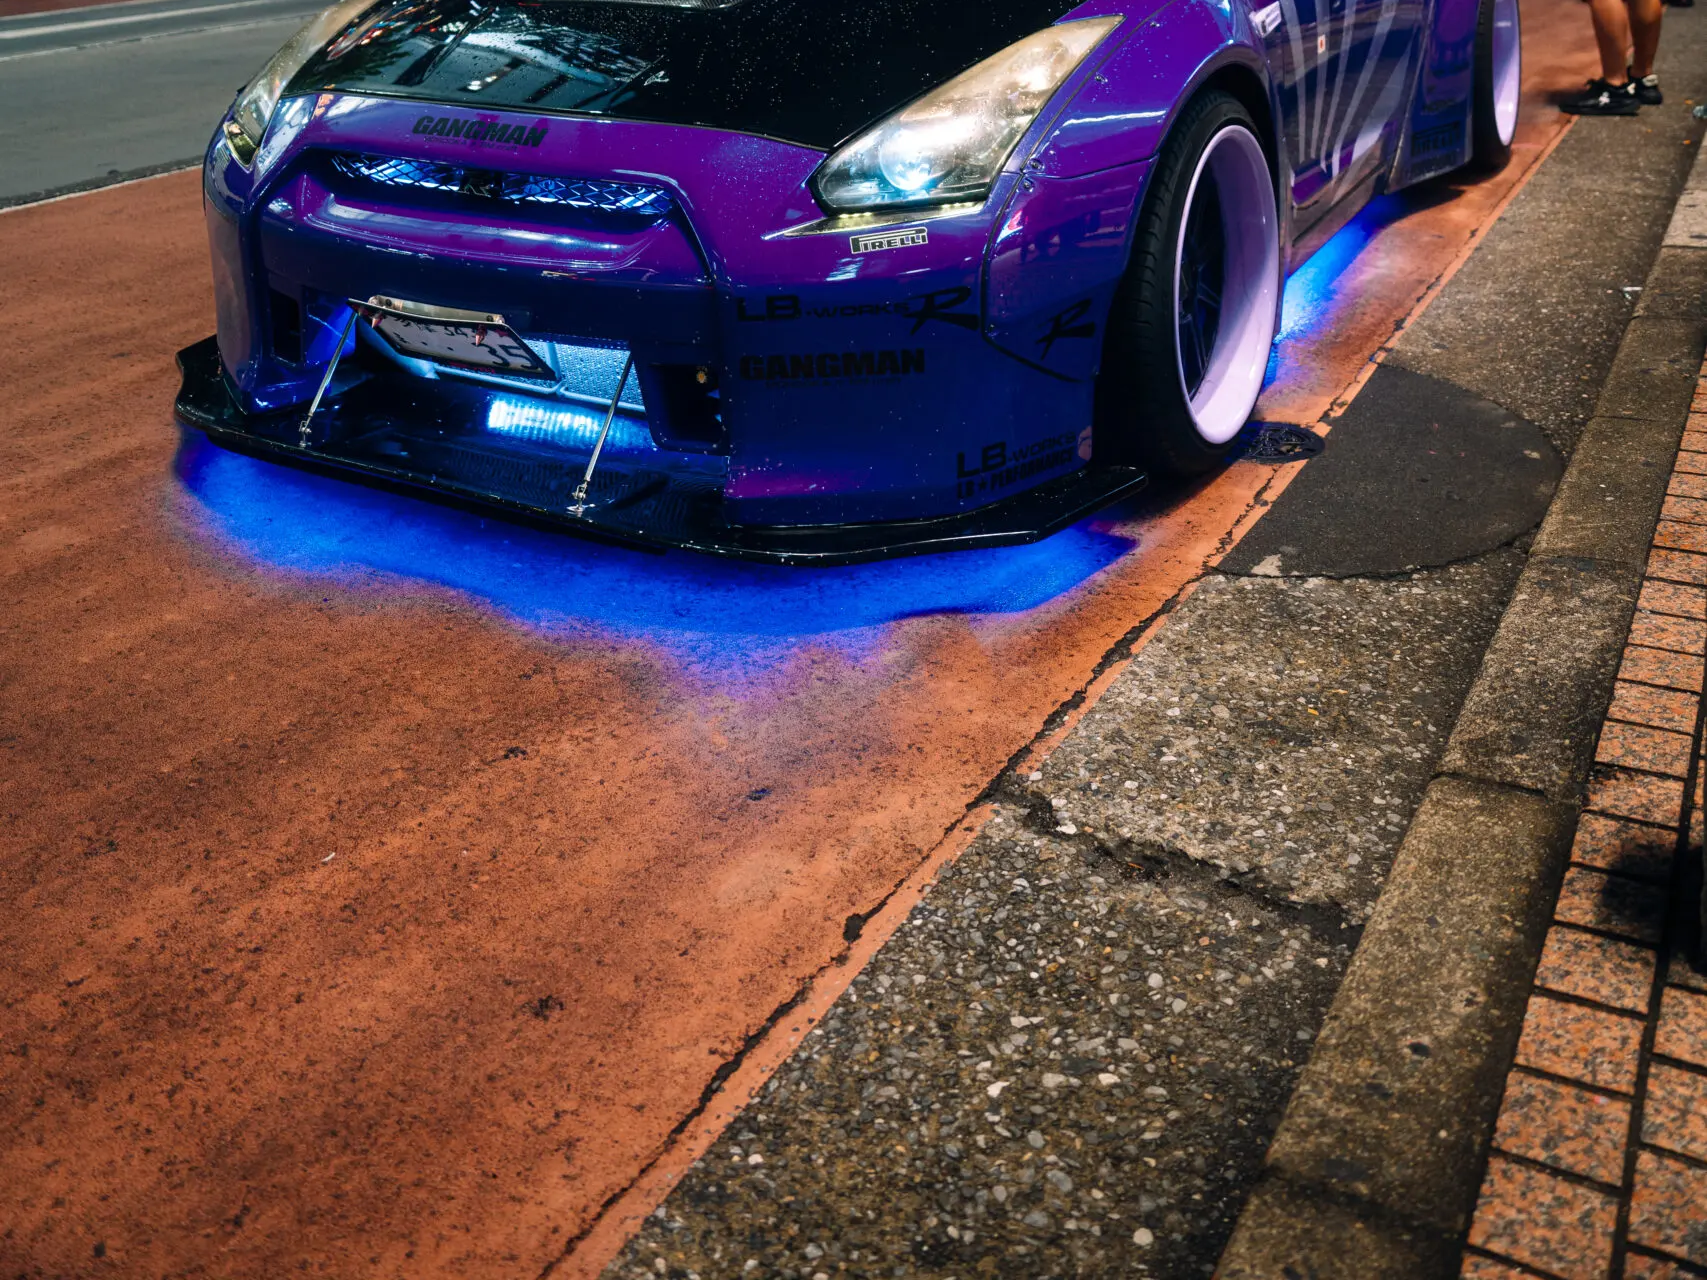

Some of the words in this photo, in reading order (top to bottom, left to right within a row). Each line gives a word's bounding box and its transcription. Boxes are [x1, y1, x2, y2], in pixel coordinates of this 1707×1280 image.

[412, 116, 548, 147] GANGMAN
[851, 228, 927, 253] PIRELLI
[740, 348, 925, 381] GANGMAN
